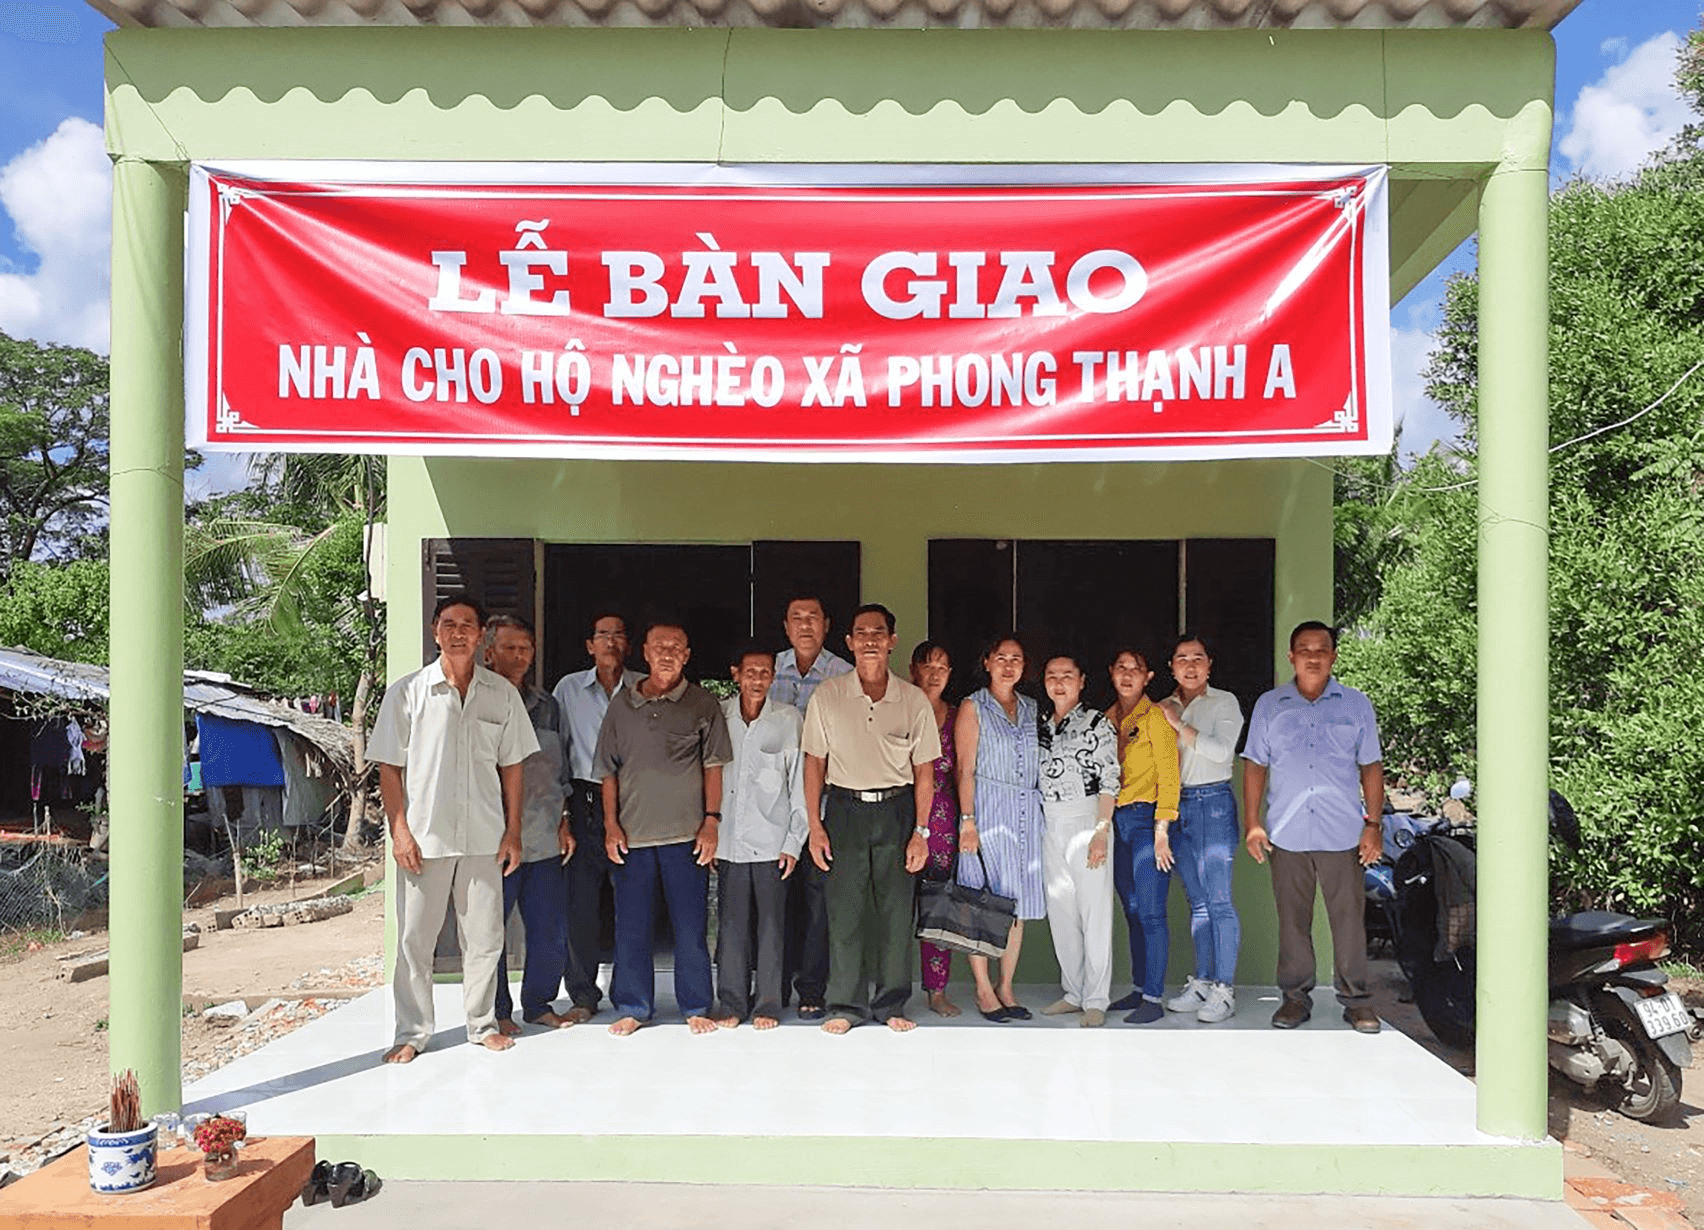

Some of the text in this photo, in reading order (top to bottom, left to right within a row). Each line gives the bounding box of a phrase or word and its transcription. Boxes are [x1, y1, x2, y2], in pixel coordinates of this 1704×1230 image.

[430, 219, 1148, 319] LỄ BÀN GIAO
[279, 332, 1296, 416] NHÀ CHO HỘ NGHÈO XÃ PHONG THẠNH A
